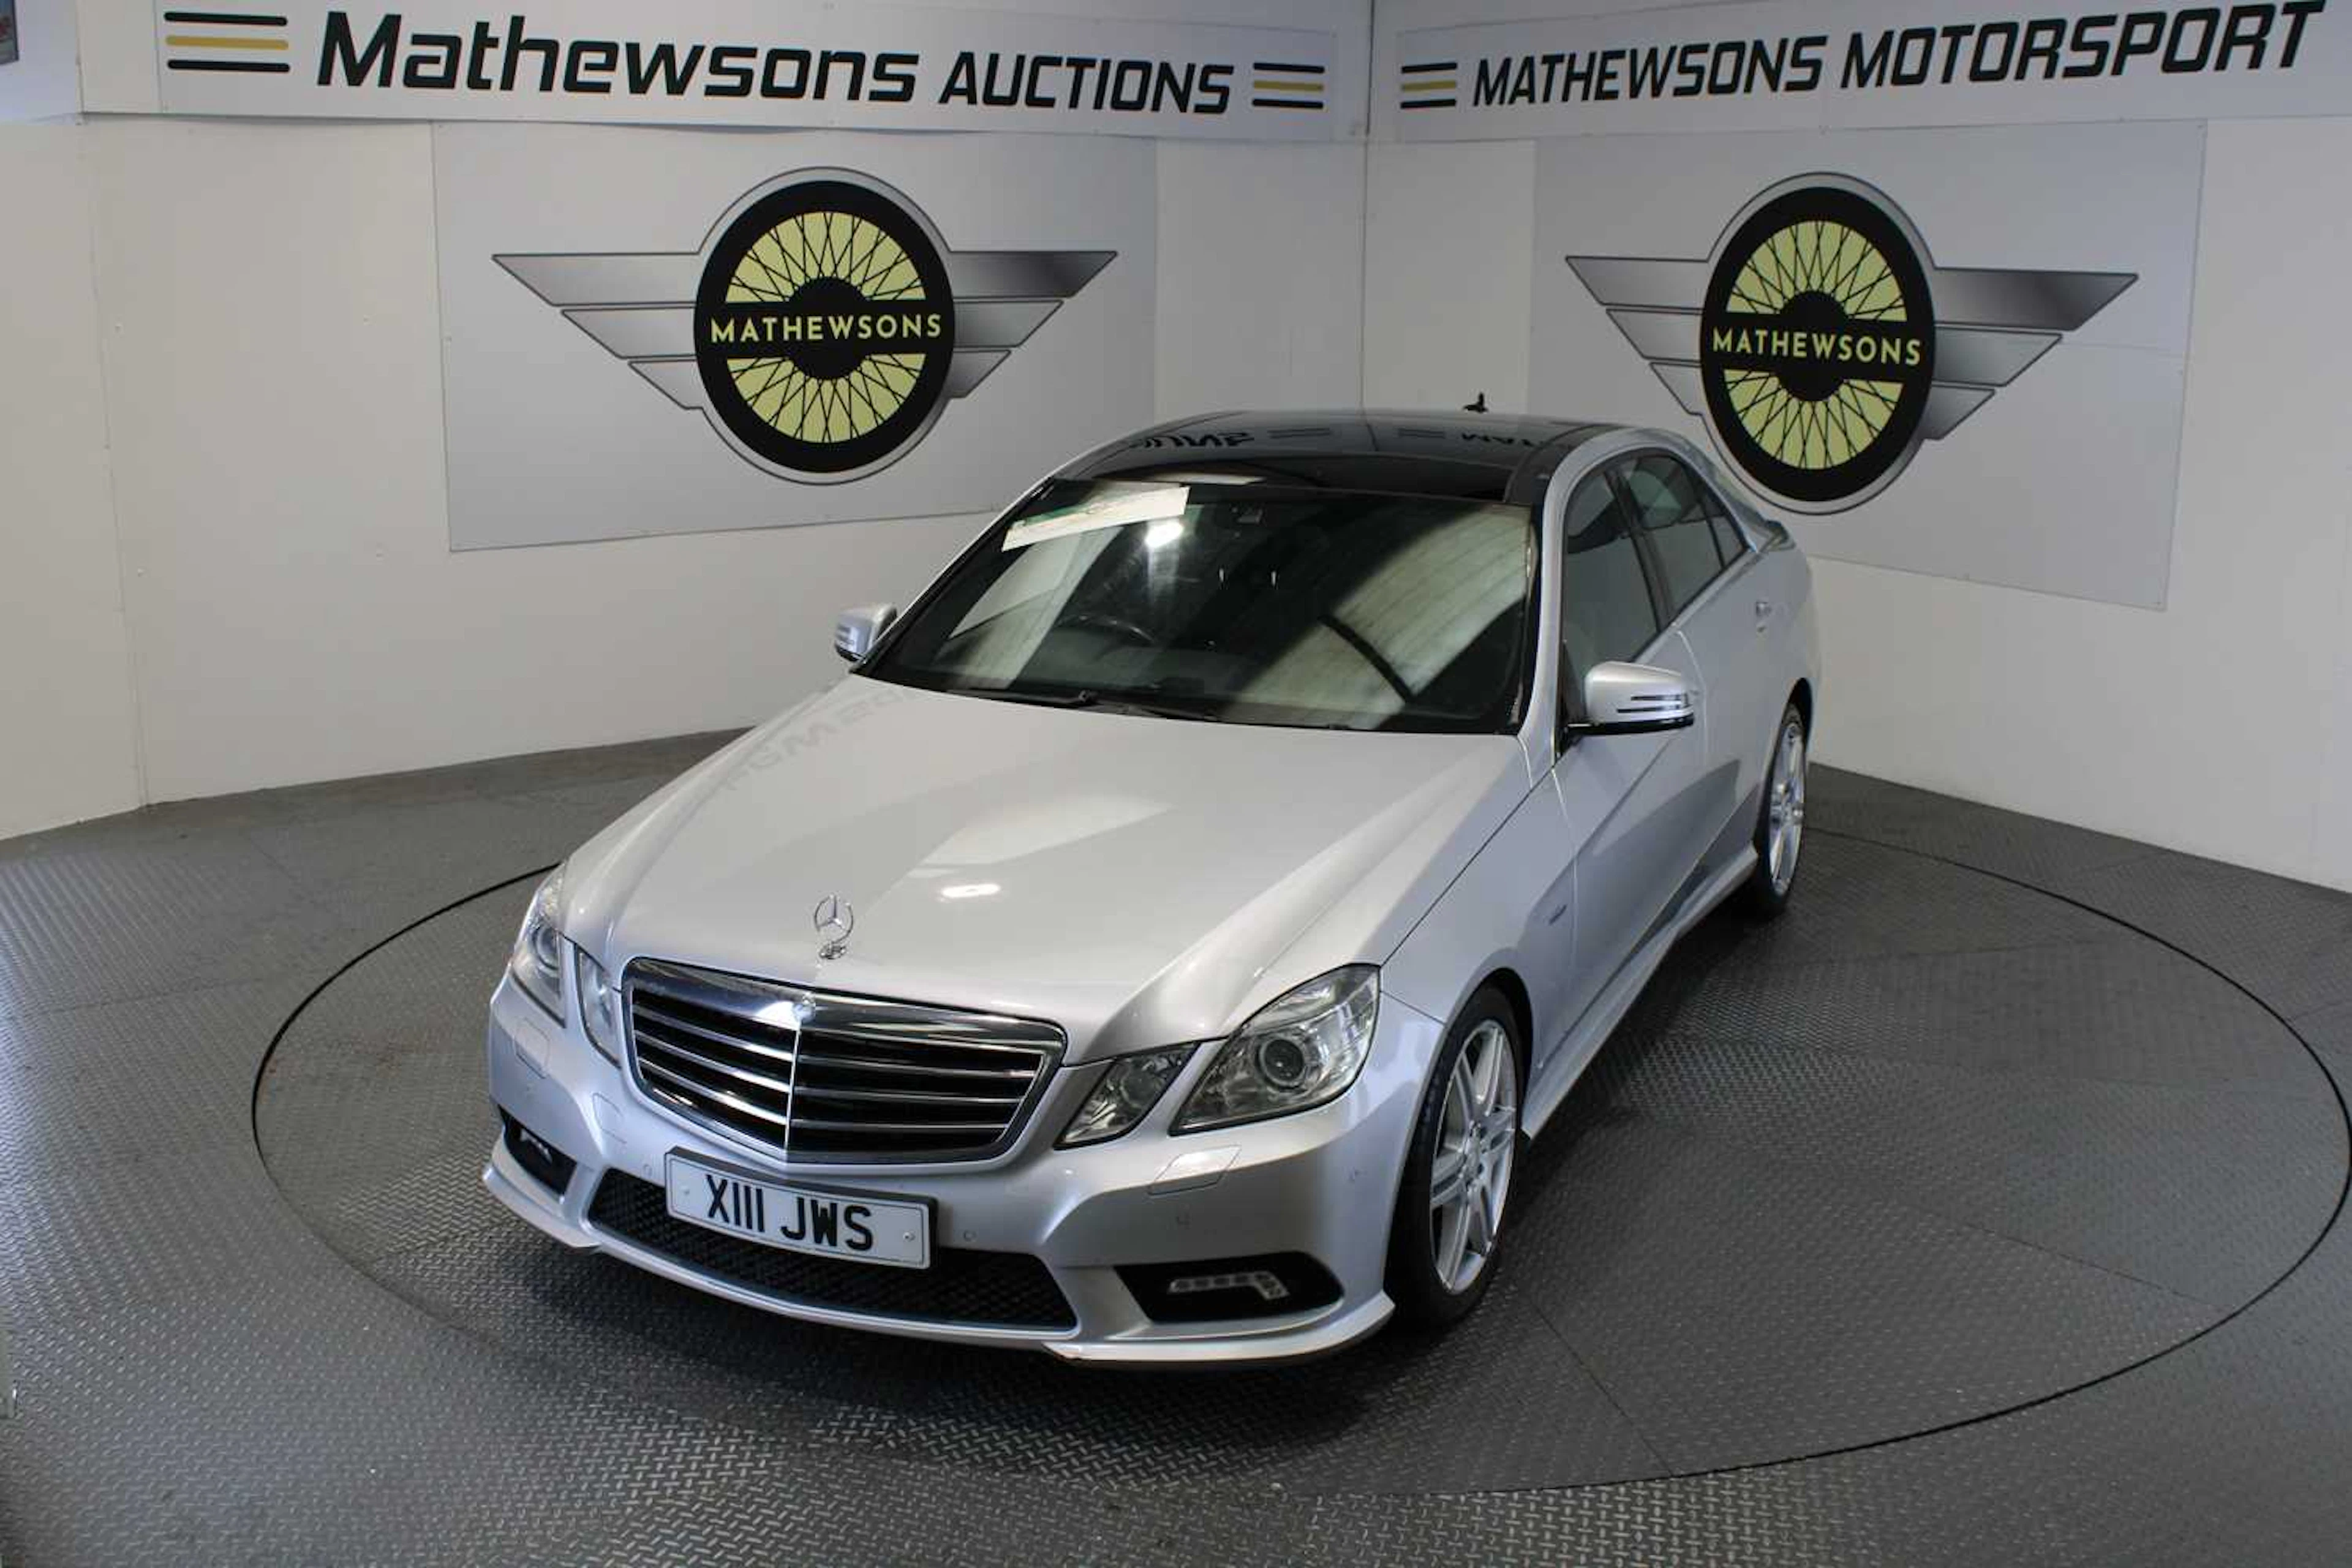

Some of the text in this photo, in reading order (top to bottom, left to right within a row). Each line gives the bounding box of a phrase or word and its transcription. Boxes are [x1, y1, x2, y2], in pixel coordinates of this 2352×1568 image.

[317, 11, 1235, 115] Mathewsons AUCTIONS
[1472, 0, 2327, 107] MATHEWSONS MOTORSPORT
[710, 313, 941, 344] MATHEWSONS
[1713, 328, 1921, 366] MATHEWSONS
[780, 1196, 873, 1252] JWS
